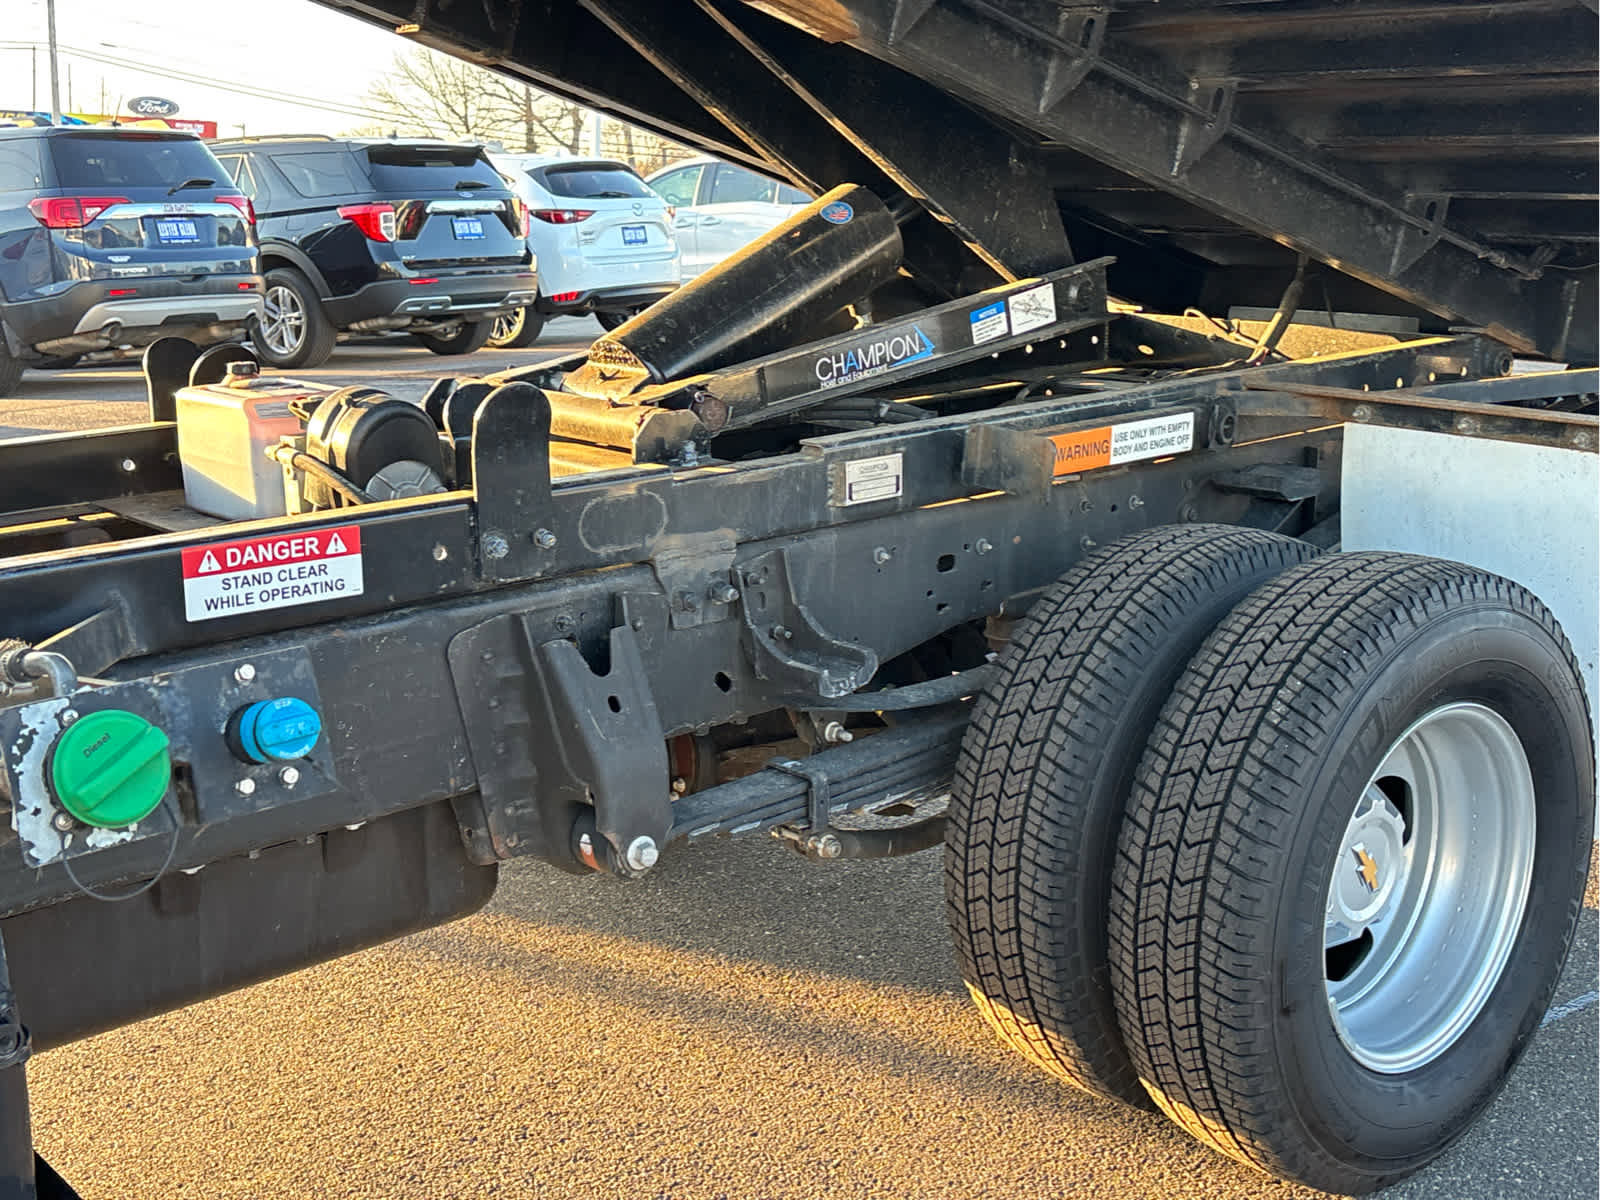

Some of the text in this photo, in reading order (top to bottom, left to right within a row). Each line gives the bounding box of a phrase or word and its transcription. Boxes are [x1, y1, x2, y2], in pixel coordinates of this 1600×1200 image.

[137, 99, 169, 114] Ford
[815, 332, 921, 380] CHAMPION
[838, 374, 852, 385] and
[1113, 432, 1191, 457] BODY AND ENGINE OFF
[1114, 420, 1191, 443] USE ONLY WITH EMPTY
[1055, 439, 1111, 463] WARNING
[226, 536, 321, 569] DANGER
[221, 563, 329, 592] STAND CLEAR
[204, 578, 345, 612] WHILE OPERATING
[82, 732, 112, 759] Diesel
